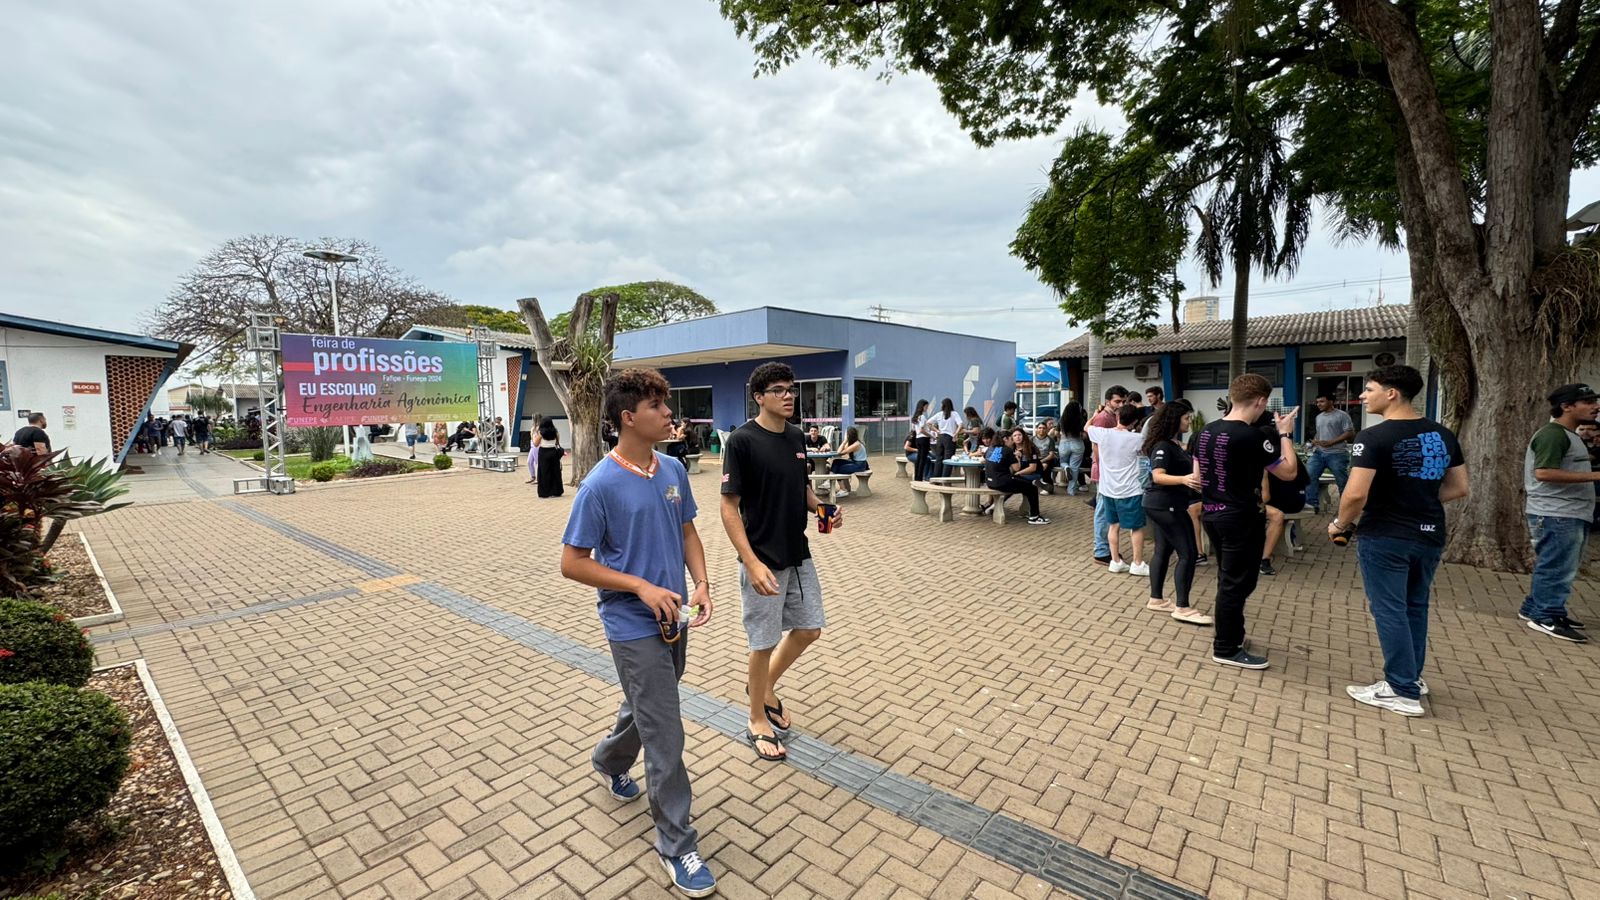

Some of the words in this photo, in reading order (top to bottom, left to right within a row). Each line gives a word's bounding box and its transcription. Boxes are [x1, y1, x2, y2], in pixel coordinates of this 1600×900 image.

[312, 337, 338, 348] feira
[341, 338, 356, 349] de
[313, 348, 443, 375] profissões
[406, 374, 428, 382] Funepe
[299, 383, 317, 396] EU
[320, 383, 376, 396] ESCOLHO
[303, 394, 391, 418] Engenharia
[397, 392, 471, 413] Agronômica
